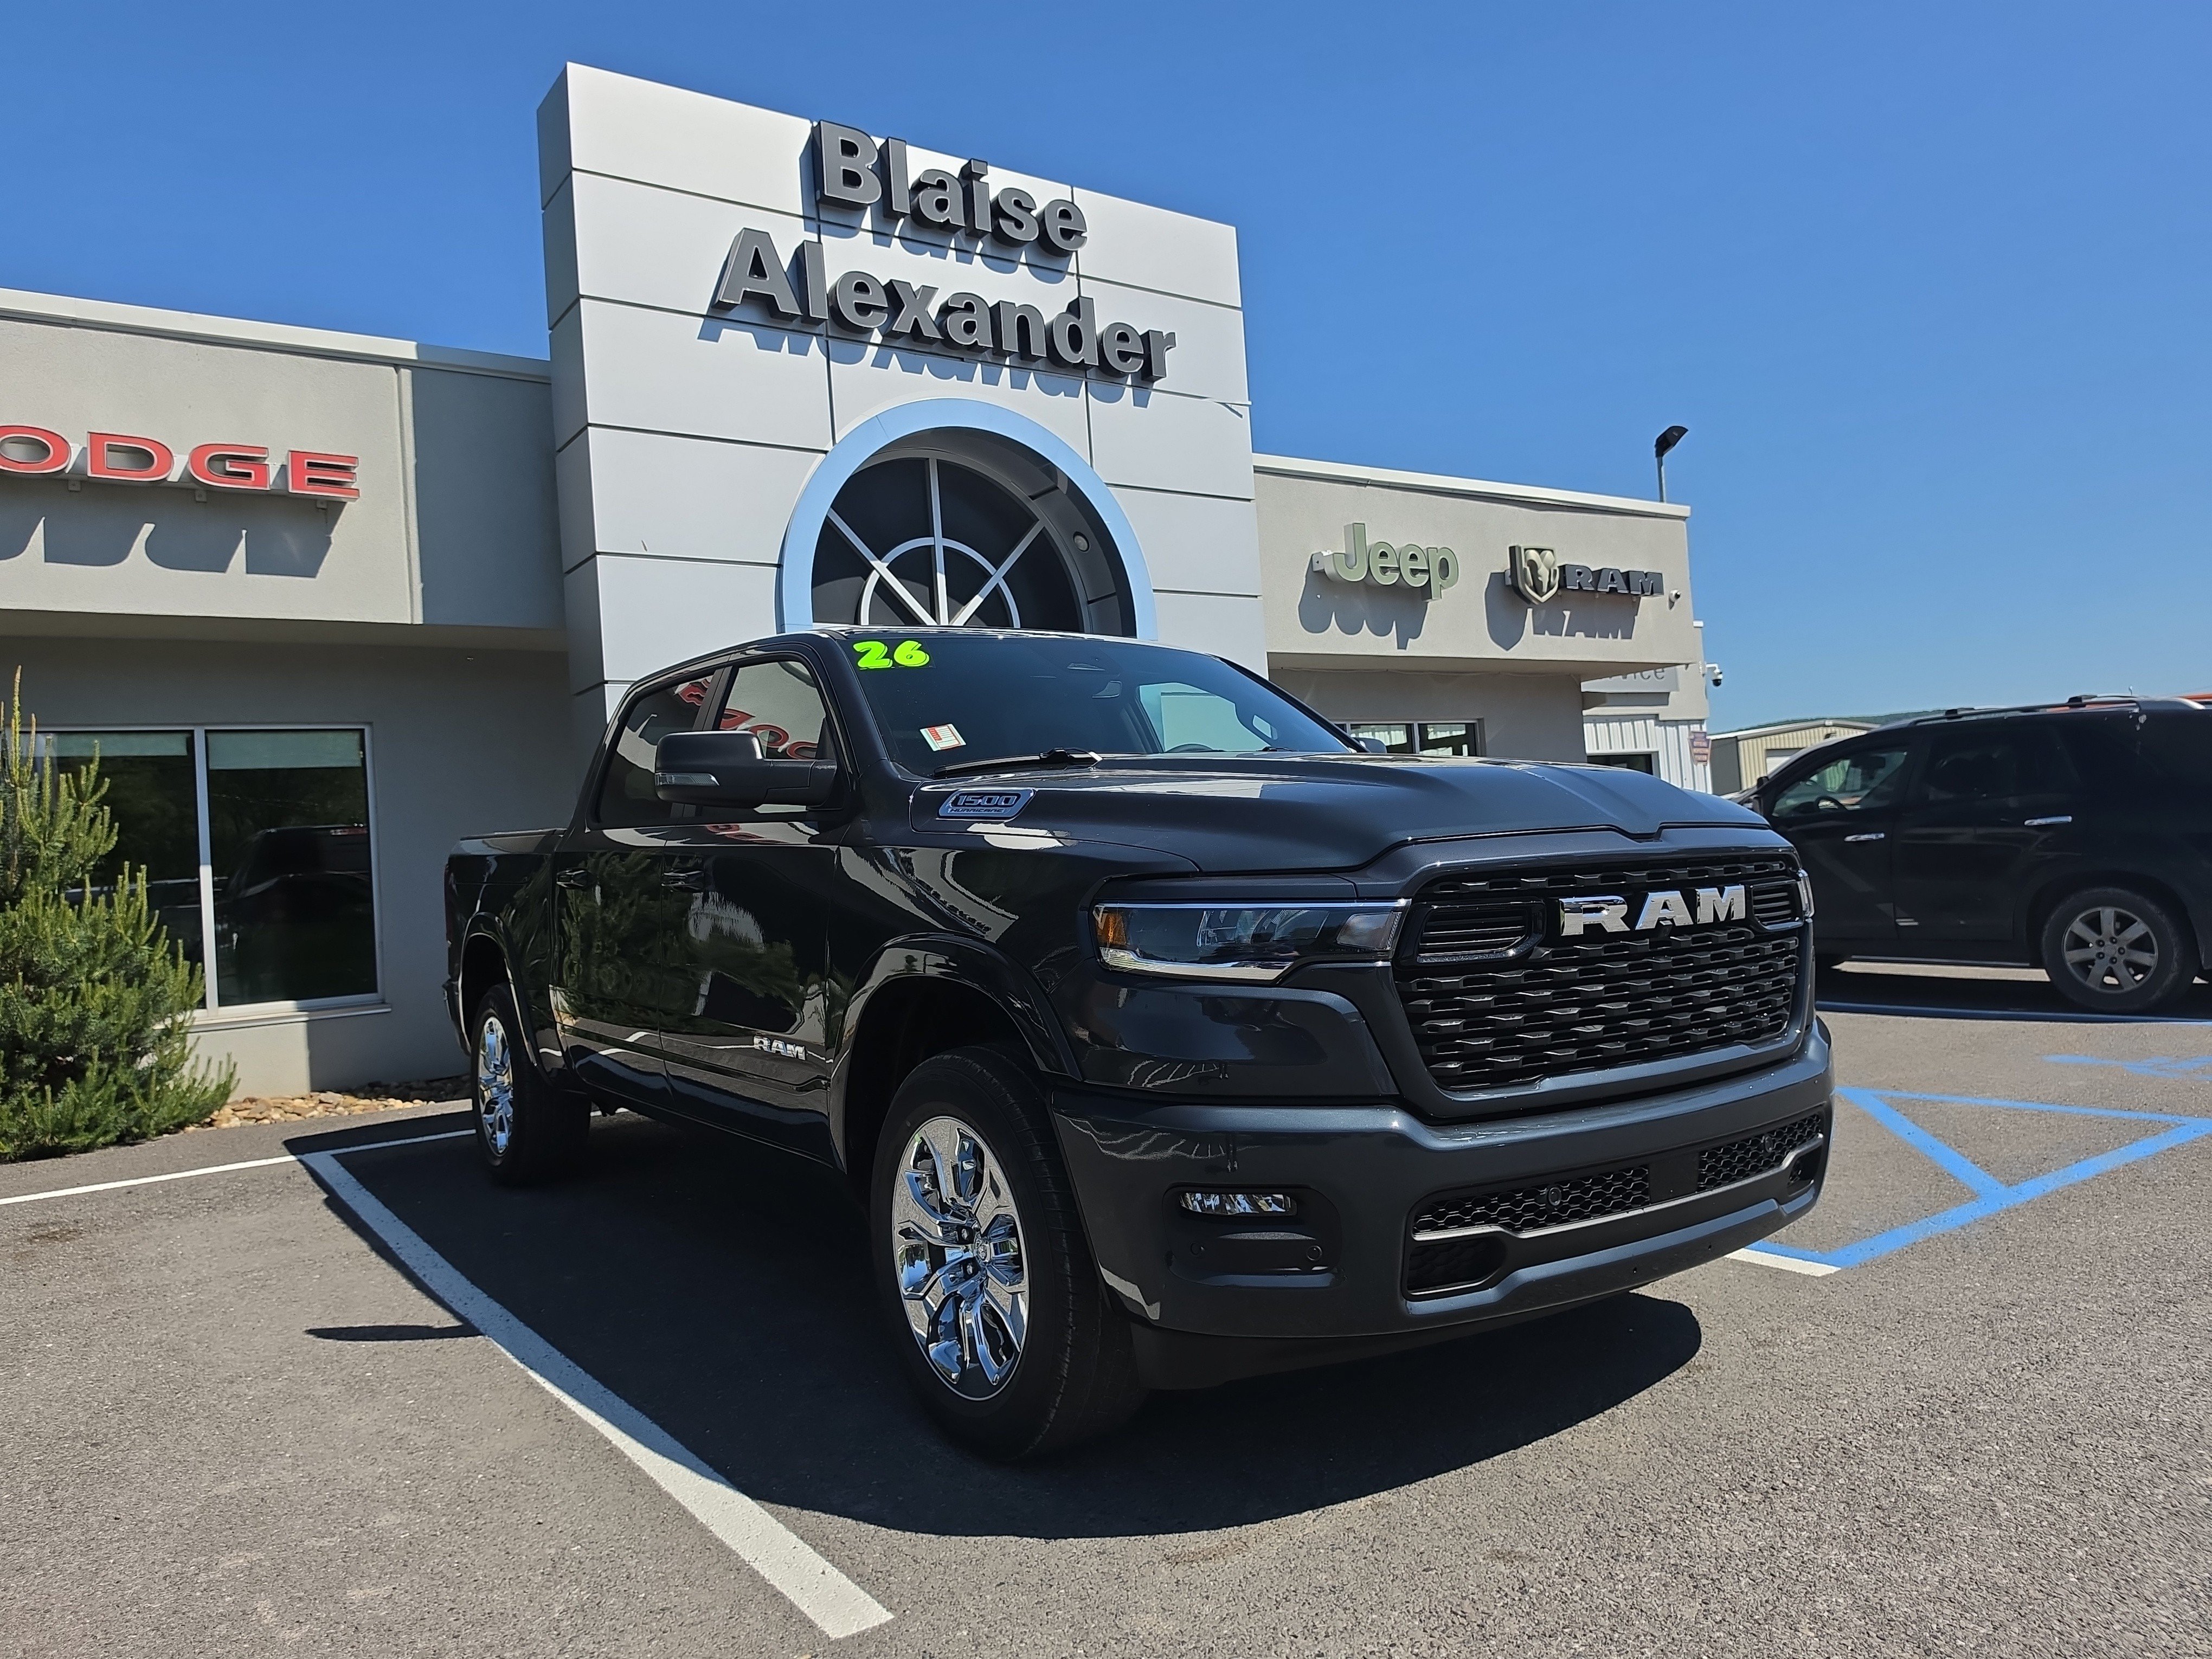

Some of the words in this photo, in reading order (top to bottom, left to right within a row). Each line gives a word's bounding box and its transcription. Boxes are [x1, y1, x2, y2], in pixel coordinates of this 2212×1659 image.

[818, 119, 1088, 254] Blaise
[713, 228, 1176, 381] Alexander
[1332, 523, 1459, 600] Jeep
[1565, 564, 1664, 596] RAM
[853, 640, 930, 669] 26
[957, 795, 1018, 806] 1500
[1559, 884, 1746, 936] RAM
[753, 1035, 806, 1060] RAM
